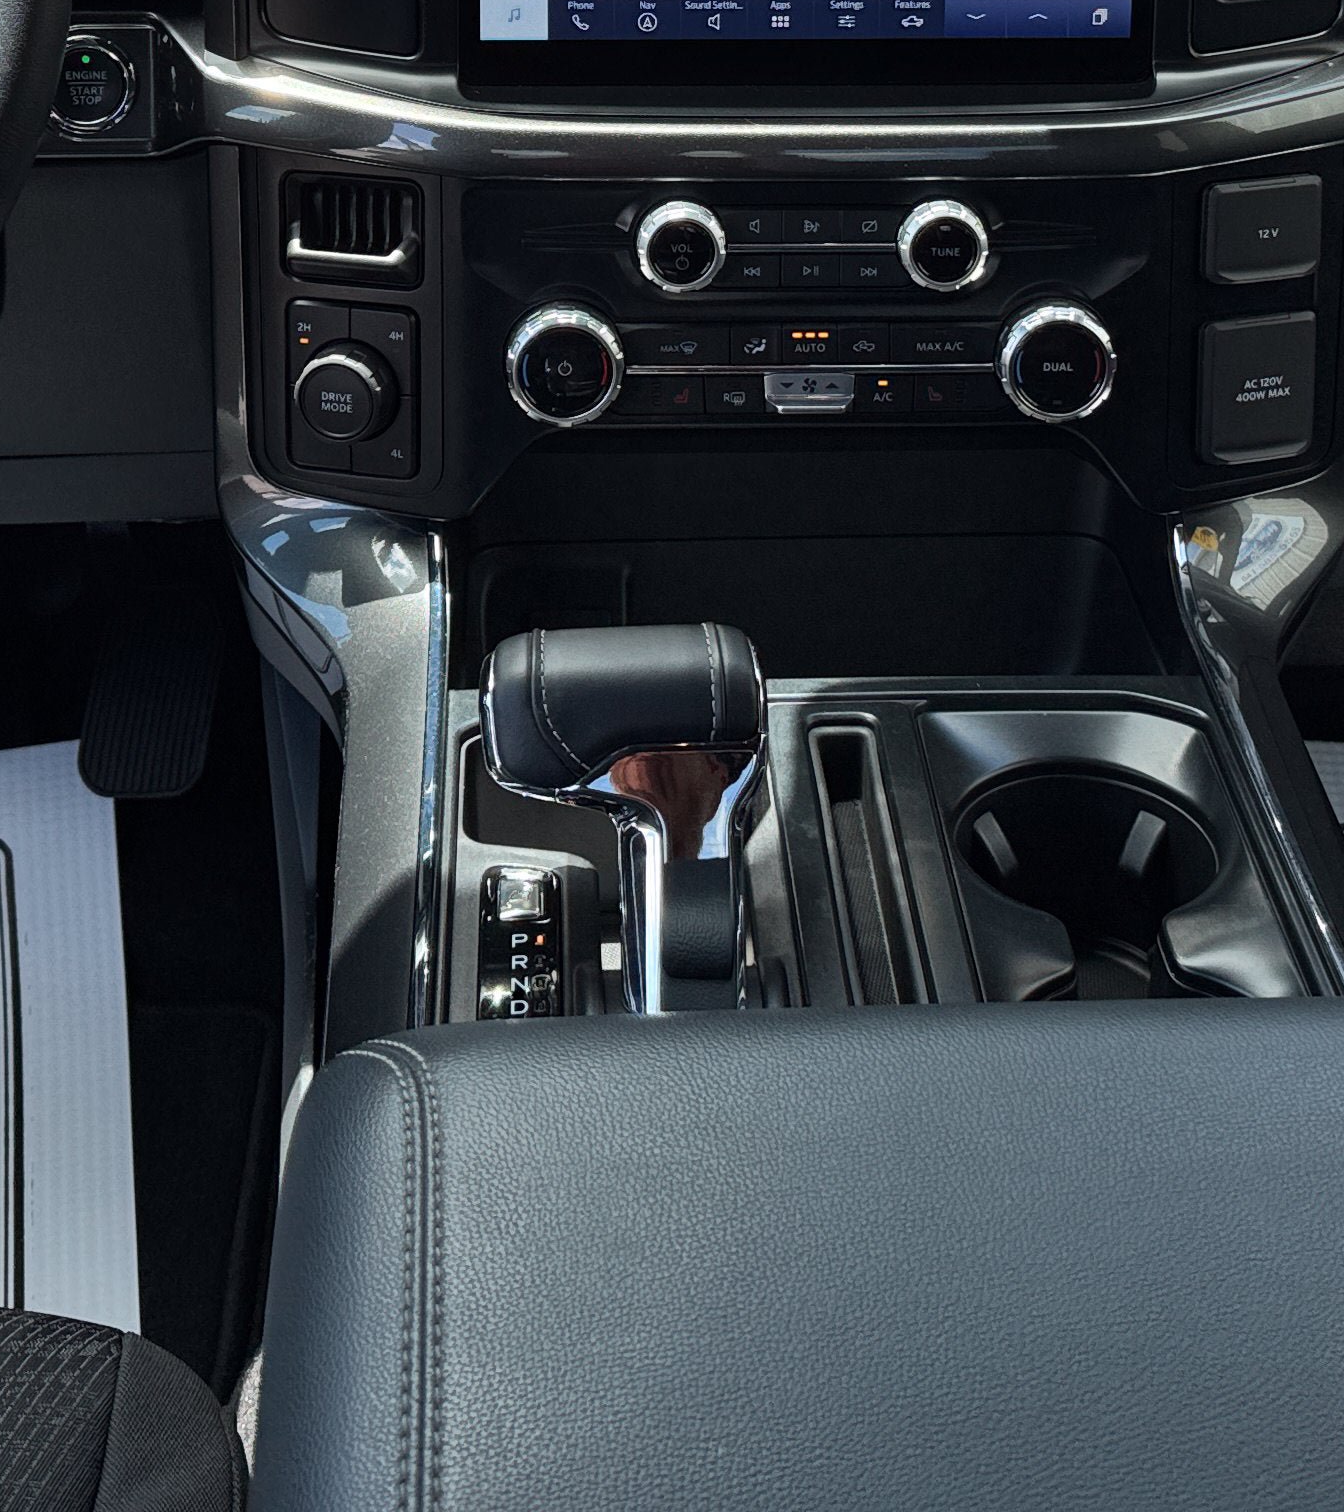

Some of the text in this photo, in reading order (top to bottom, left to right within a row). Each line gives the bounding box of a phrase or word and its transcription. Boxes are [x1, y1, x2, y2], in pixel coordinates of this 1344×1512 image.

[567, 0, 595, 10] Phone
[639, 0, 656, 10] Nav
[684, 0, 712, 10] Sound
[769, 0, 791, 12] Apps
[829, 0, 865, 11] Settings
[894, 0, 931, 9] Features
[65, 70, 108, 81] ENGINE
[69, 85, 105, 96] START
[72, 95, 103, 106] STOP
[670, 244, 693, 254] VOL
[931, 248, 960, 257] TUNE
[296, 322, 312, 332] 2H
[388, 331, 404, 341] 4H
[659, 345, 681, 353] MAX
[794, 343, 826, 353] AUTO
[916, 341, 965, 352] MAX A/C
[1042, 362, 1074, 372] DUAL
[1244, 376, 1283, 389] AC 120V
[321, 391, 353, 403] DRIVE
[873, 392, 893, 402] A/C
[1235, 387, 1291, 402] 400W MAX
[321, 402, 353, 414] MODE
[390, 449, 404, 459] 4L
[511, 934, 528, 948] P
[511, 955, 528, 970] R
[510, 977, 529, 992] N
[510, 999, 529, 1015] D
